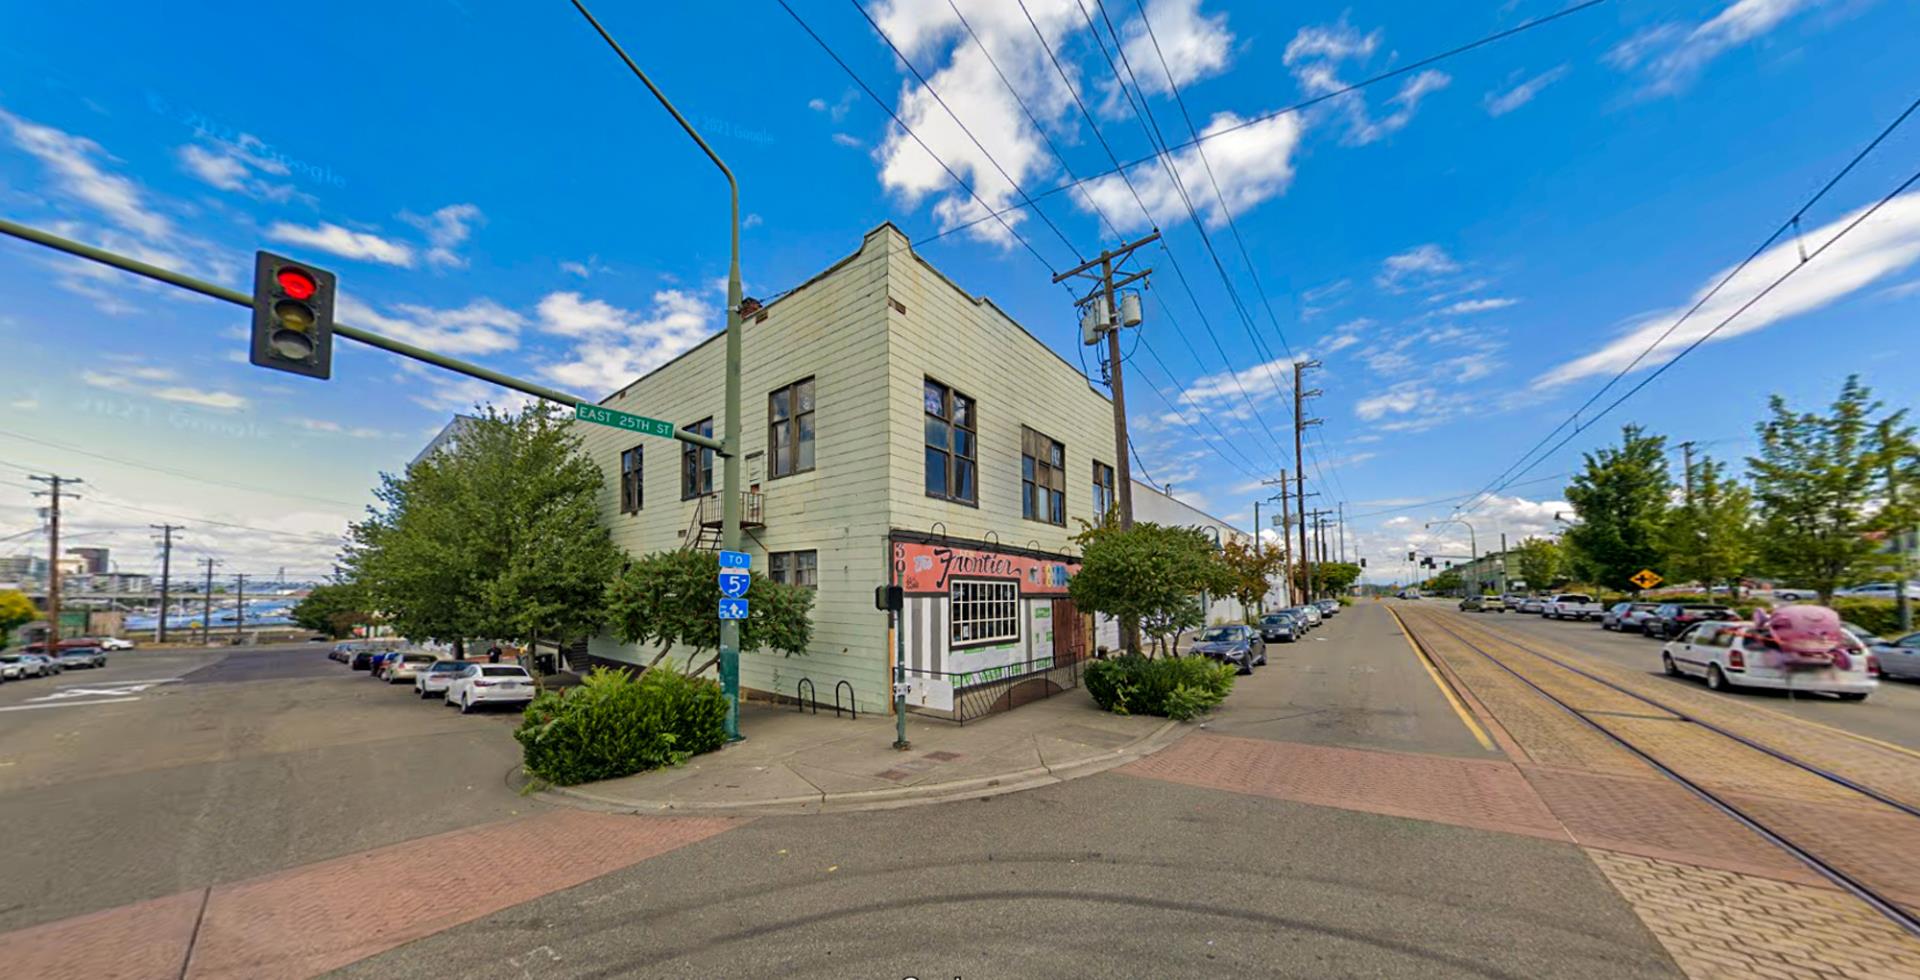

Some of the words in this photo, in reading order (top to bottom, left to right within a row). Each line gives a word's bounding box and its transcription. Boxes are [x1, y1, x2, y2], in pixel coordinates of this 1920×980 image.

[580, 407, 612, 423] EAST
[620, 416, 650, 431] 25TH
[656, 425, 671, 435] ST
[729, 555, 743, 565] TO
[934, 547, 1022, 589] Frontier
